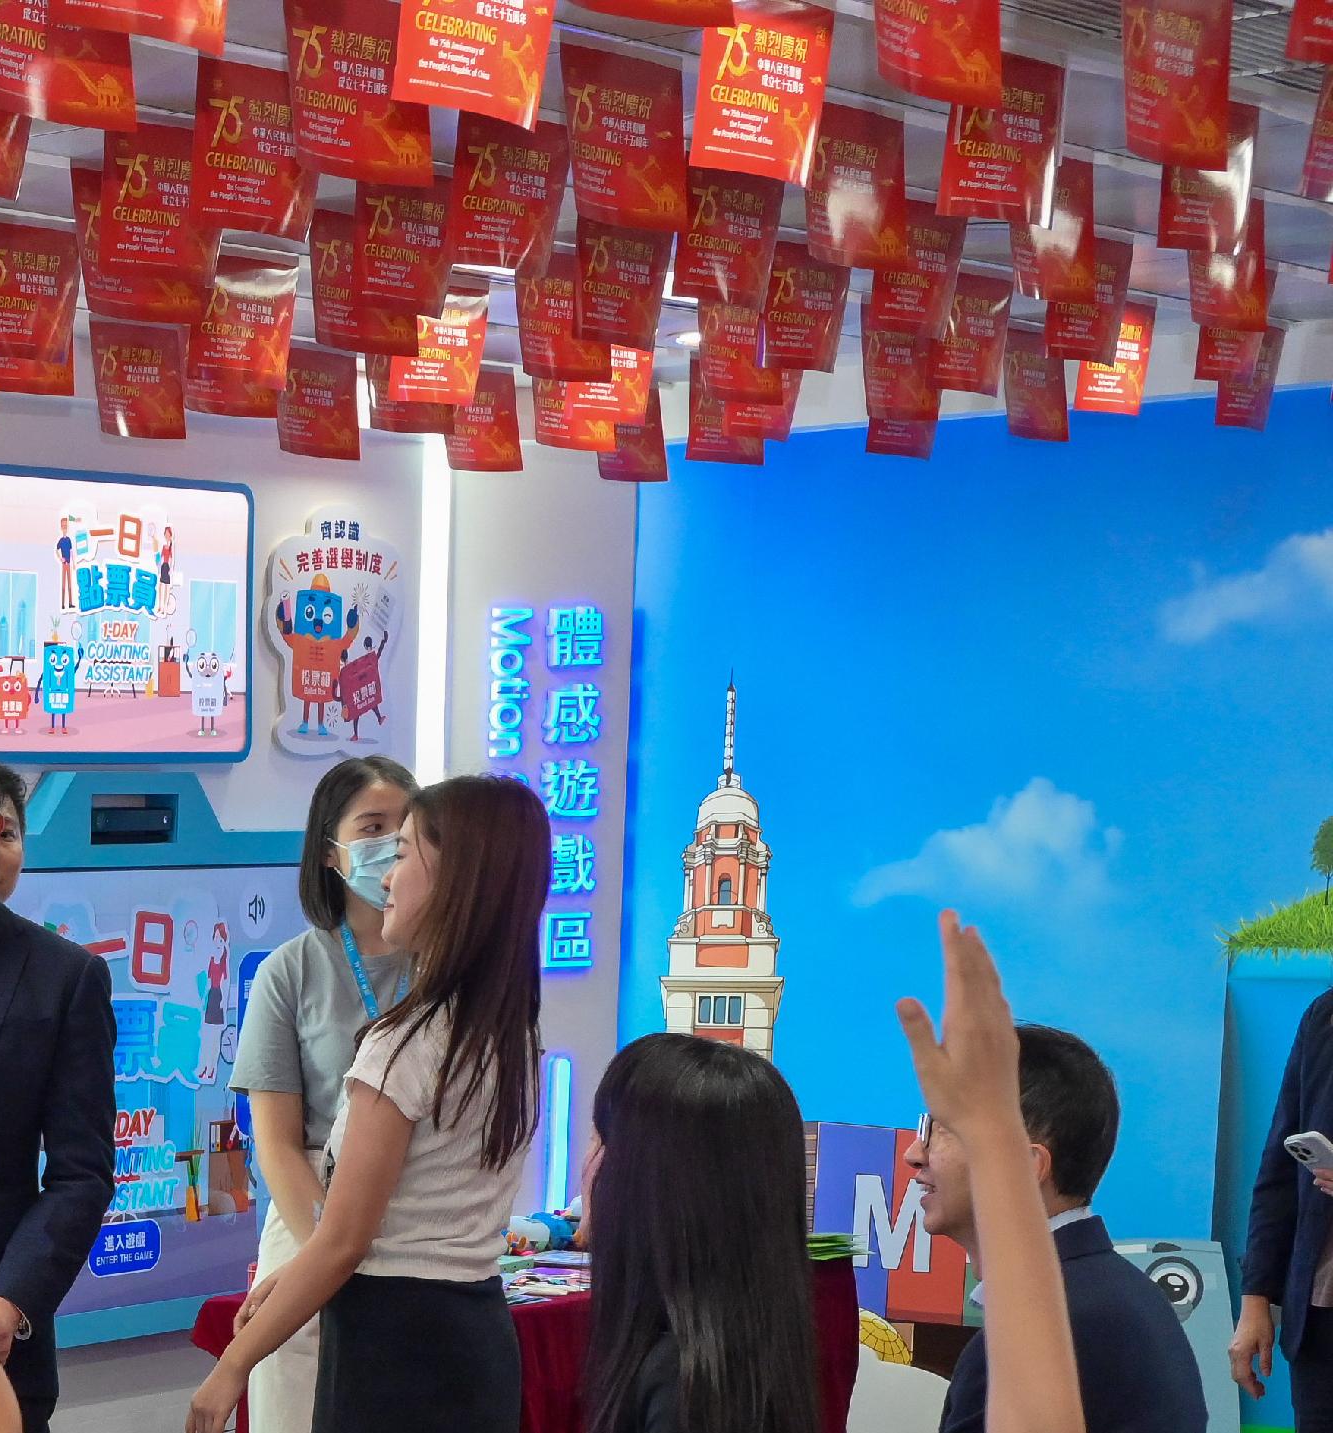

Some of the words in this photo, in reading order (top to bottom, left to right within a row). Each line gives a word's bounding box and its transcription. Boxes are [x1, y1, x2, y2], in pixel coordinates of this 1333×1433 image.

[415, 10, 497, 45] CELEBRATING
[292, 24, 327, 81] 75
[330, 30, 392, 65] 熱烈慶祝
[717, 23, 752, 80] 75
[753, 28, 808, 63] 熱烈慶祝
[338, 77, 389, 95] 成立七十五周年
[710, 84, 779, 113] CELEBRATING
[762, 74, 804, 94] 成立七十五周年
[295, 86, 358, 116] CELEBRATING
[208, 96, 245, 148] 75
[206, 152, 277, 176] CELEBRATING
[958, 140, 1021, 163] CELEBRATING
[116, 153, 150, 203] 75
[467, 143, 499, 191] 75
[113, 206, 180, 227] CELEBRATING
[462, 194, 525, 216] CELEBRATING
[364, 243, 420, 263] CELEBRATING
[89, 514, 142, 558] 一日
[320, 520, 361, 541] 齊認識
[296, 546, 383, 575] 完善選舉制度
[76, 563, 158, 616] 點票員
[103, 622, 138, 638] 1-DAY
[87, 643, 150, 660] COUNTING
[85, 666, 152, 682] ASSISTANT
[301, 669, 331, 688] 投票箱
[487, 606, 533, 759] Motion
[541, 605, 604, 969] 體感遊戲區
[104, 1231, 146, 1252] 進入遊戲
[96, 1254, 118, 1266] ENTER
[120, 1253, 132, 1262] THE
[134, 1251, 154, 1261] GAME
